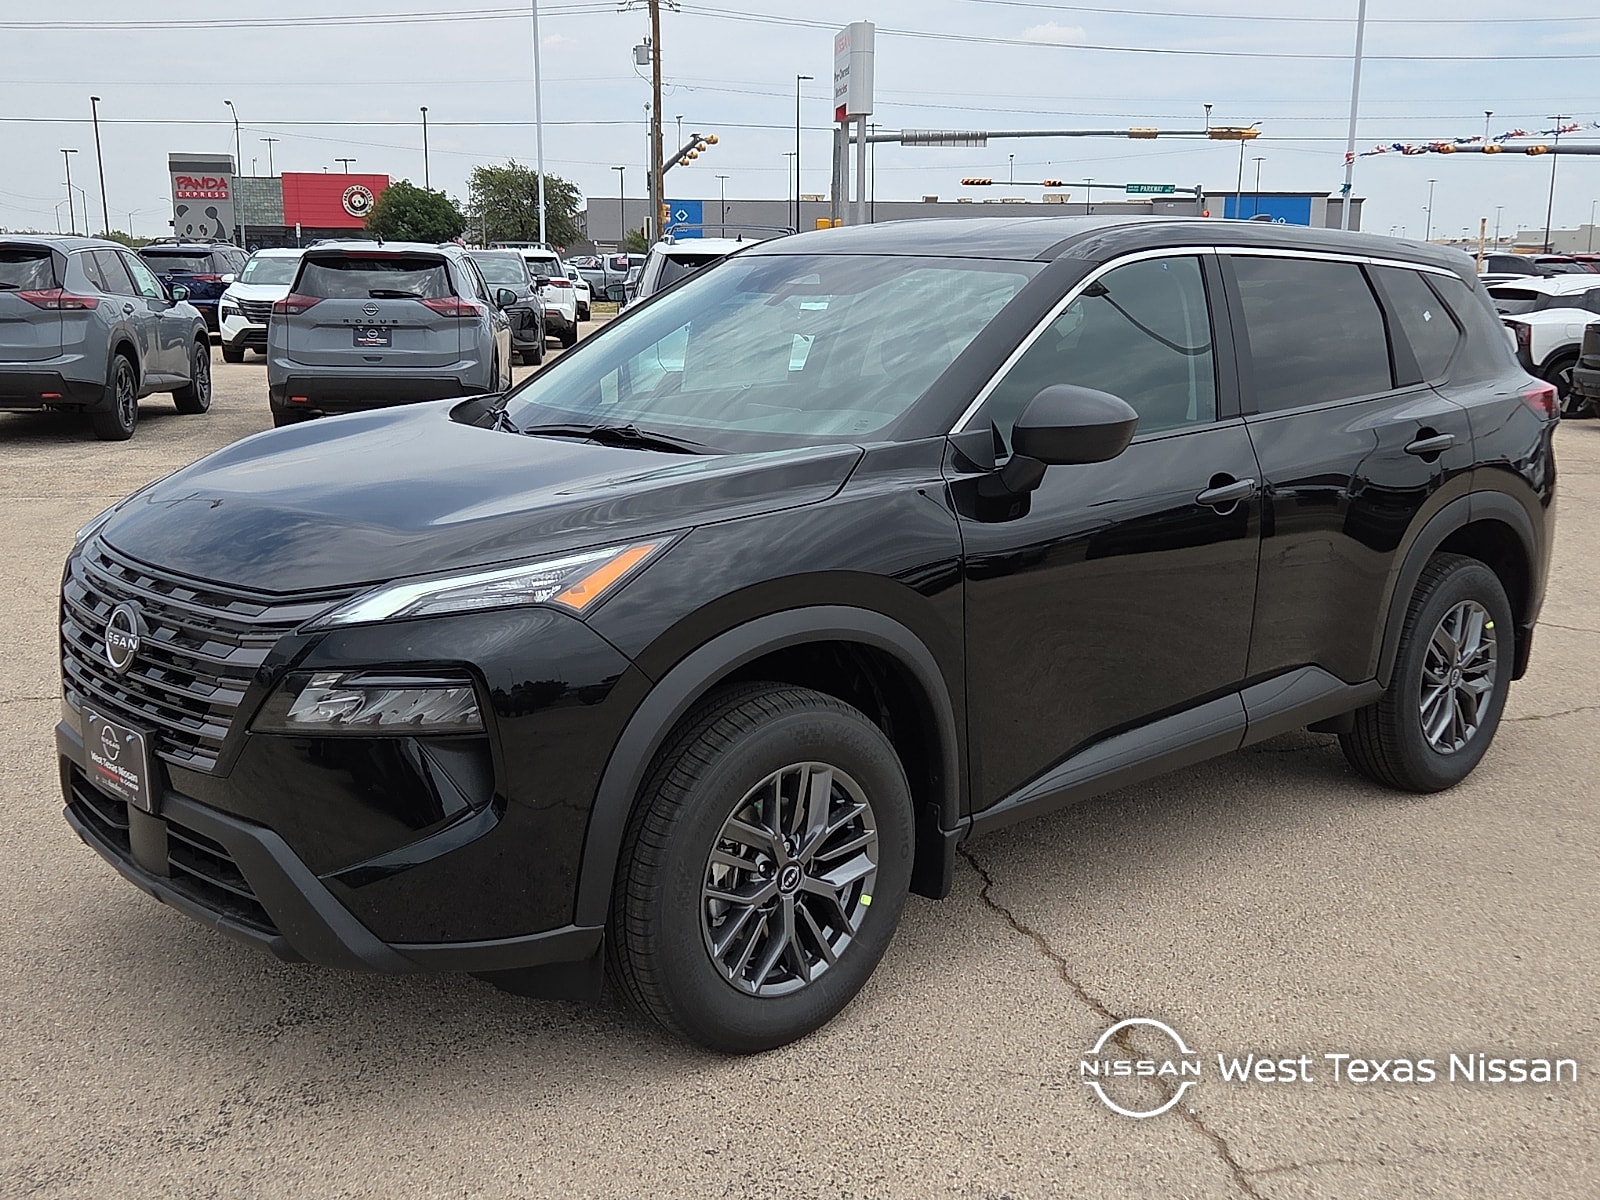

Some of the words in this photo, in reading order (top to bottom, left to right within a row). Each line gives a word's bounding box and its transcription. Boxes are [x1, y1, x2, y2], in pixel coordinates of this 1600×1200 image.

[175, 176, 228, 190] PANDA
[91, 750, 104, 766] West
[102, 758, 118, 774] Texas
[117, 766, 138, 783] Nissan
